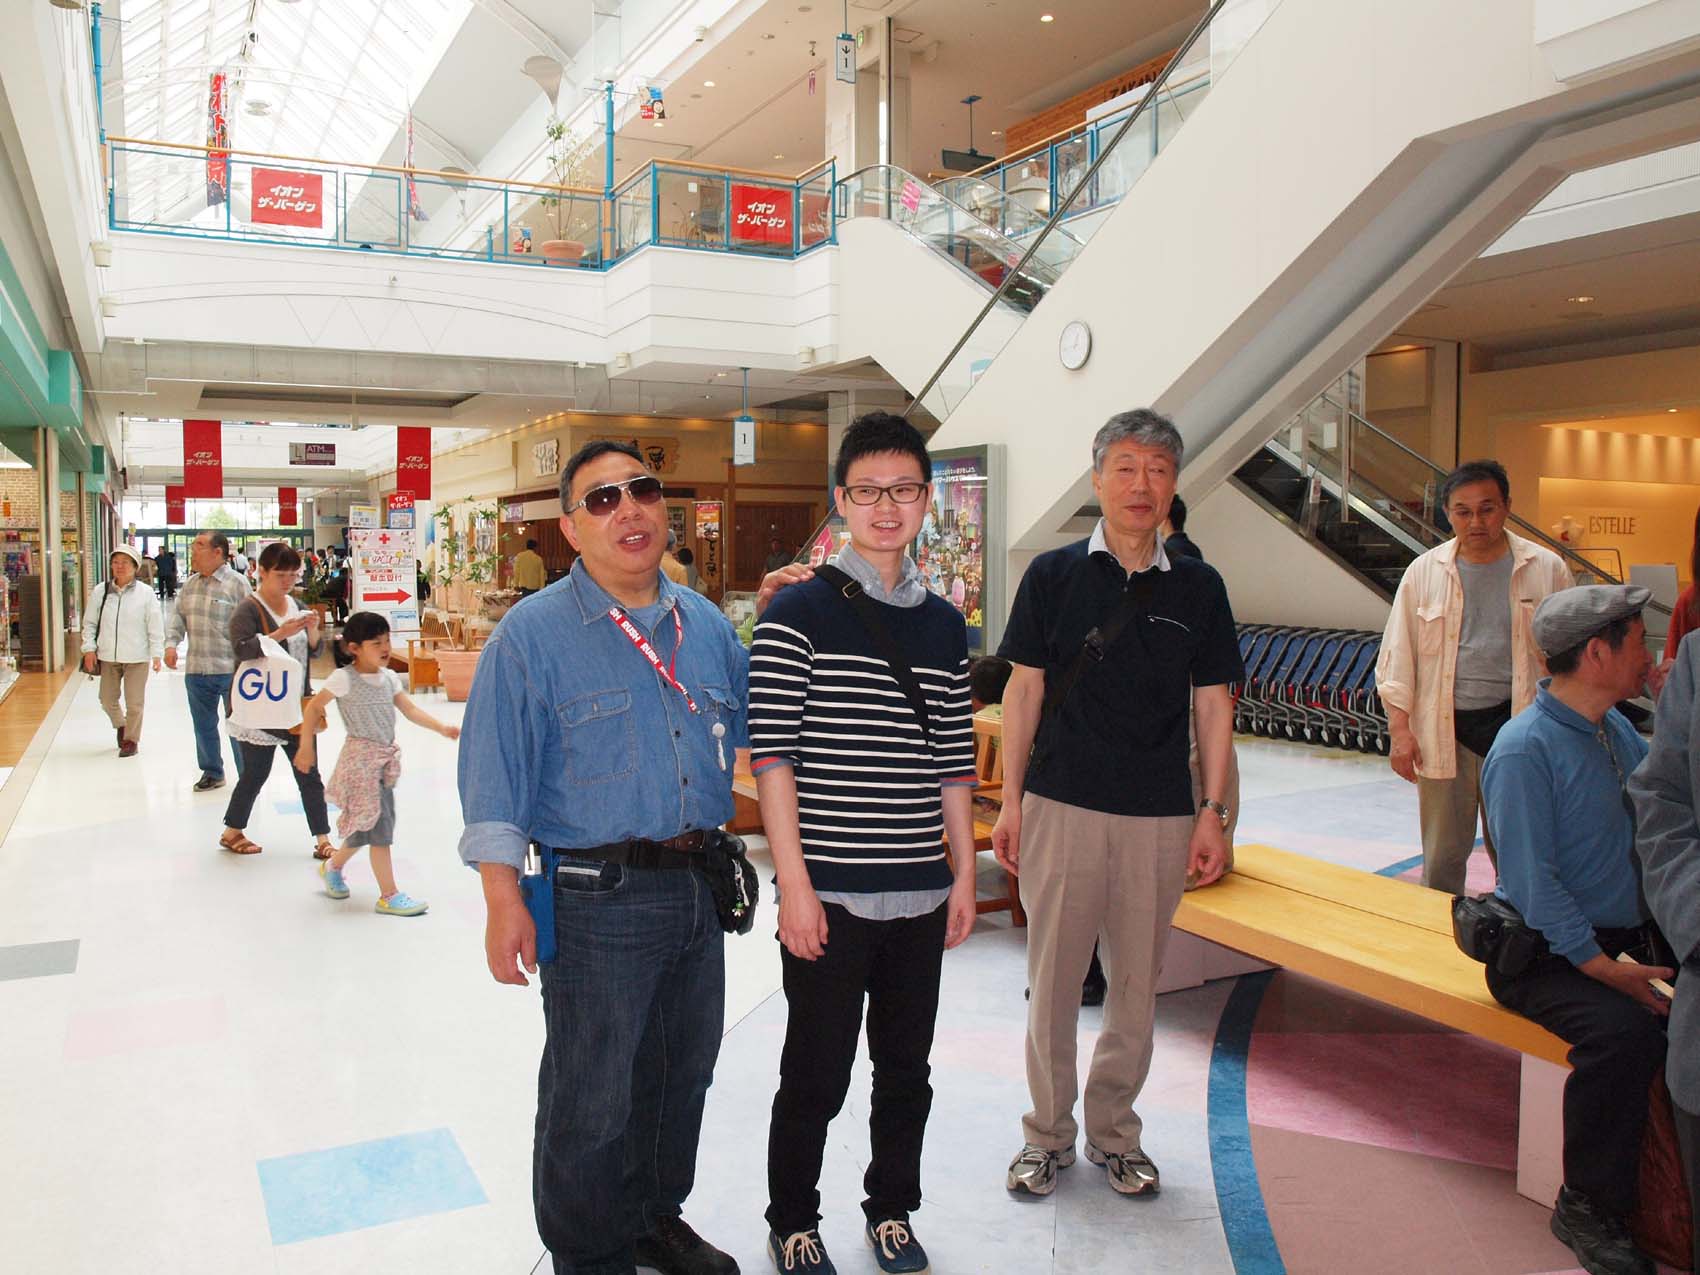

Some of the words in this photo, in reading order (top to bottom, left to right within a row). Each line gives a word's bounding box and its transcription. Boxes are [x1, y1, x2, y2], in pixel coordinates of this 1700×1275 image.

[270, 185, 304, 198] イオン
[257, 197, 316, 213] ザ・バーゲン
[747, 202, 776, 215] イオン
[737, 213, 786, 228] ザ・バーゲン
[307, 445, 325, 453] ATM
[1589, 516, 1636, 535] ESTELLE
[621, 620, 641, 642] RUSH
[640, 642, 660, 665] RUSH
[238, 668, 288, 702] GU
